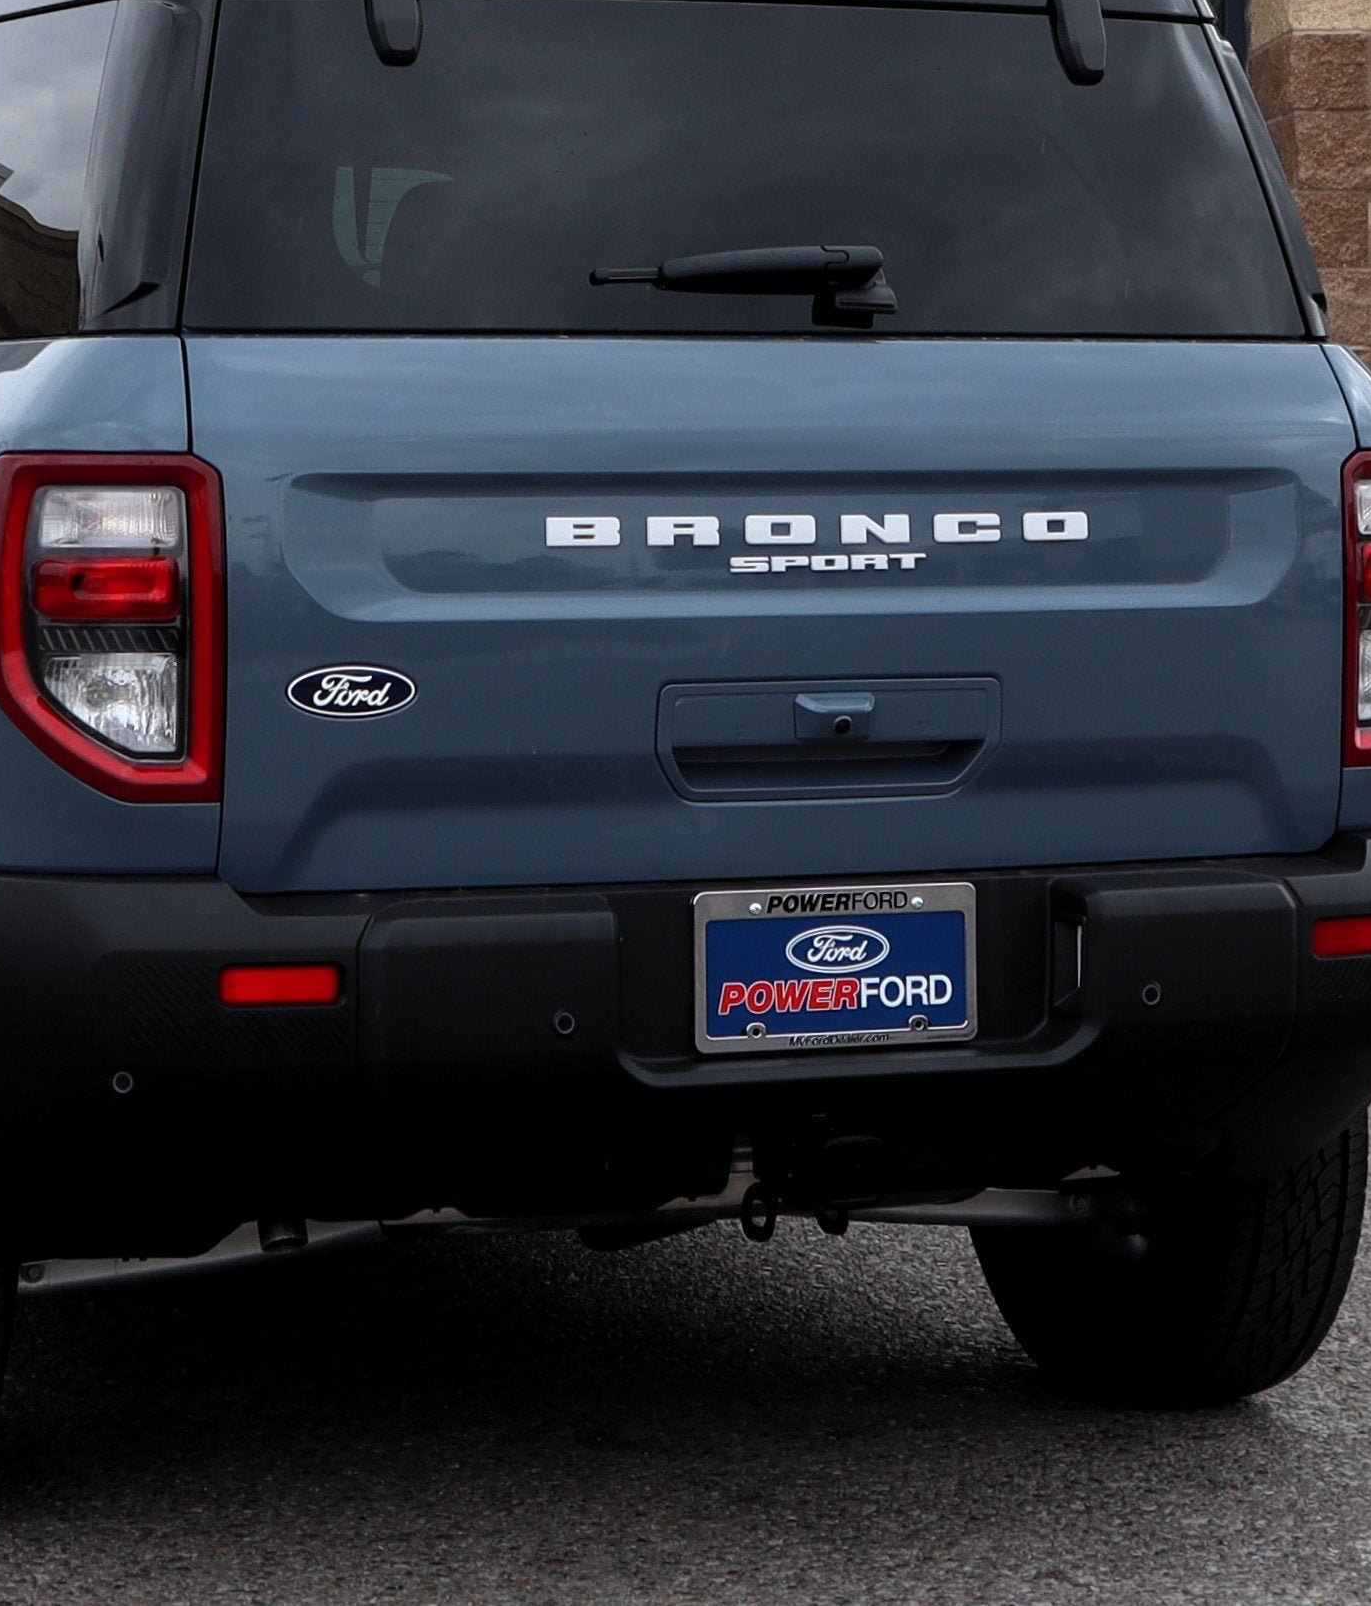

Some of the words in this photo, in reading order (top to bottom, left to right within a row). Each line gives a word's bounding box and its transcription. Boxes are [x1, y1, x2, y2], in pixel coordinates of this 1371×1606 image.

[544, 510, 1089, 548] BRONCO
[729, 551, 927, 574] SPORT
[312, 673, 392, 707] Ford
[766, 890, 908, 915] POWERFORD
[807, 934, 869, 963] Ford
[718, 974, 954, 1016] POWERFORD
